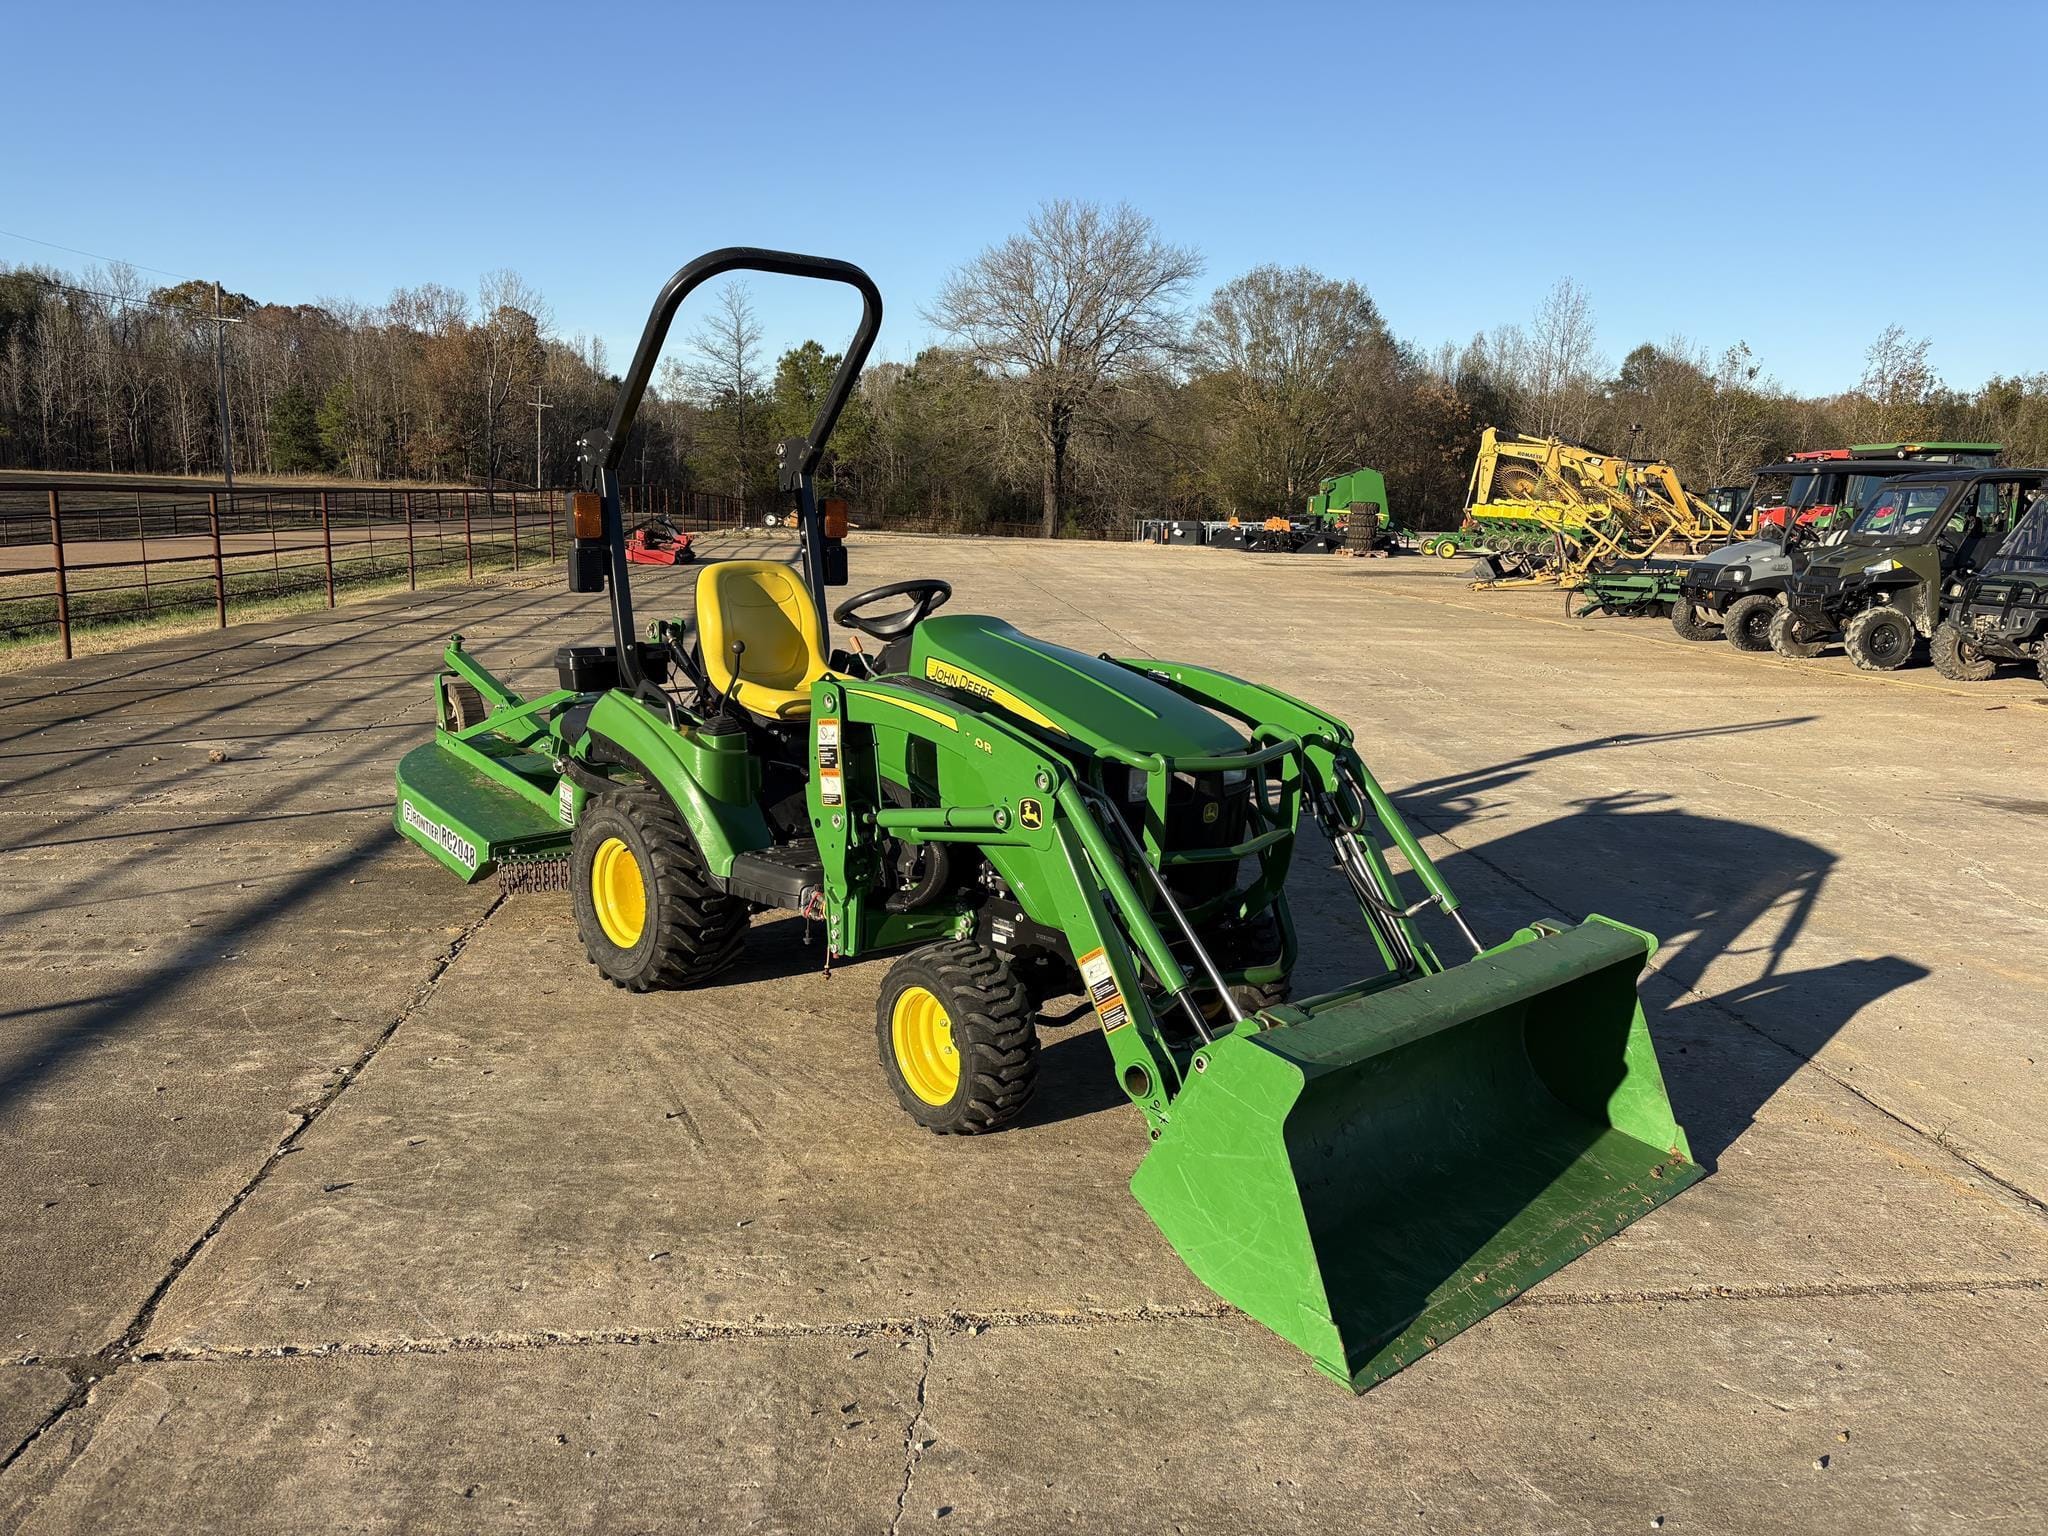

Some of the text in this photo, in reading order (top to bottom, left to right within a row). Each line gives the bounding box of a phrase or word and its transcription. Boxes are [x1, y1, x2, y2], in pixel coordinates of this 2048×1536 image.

[931, 666, 995, 699] JOHN DEERE
[441, 827, 476, 868] RC2048
